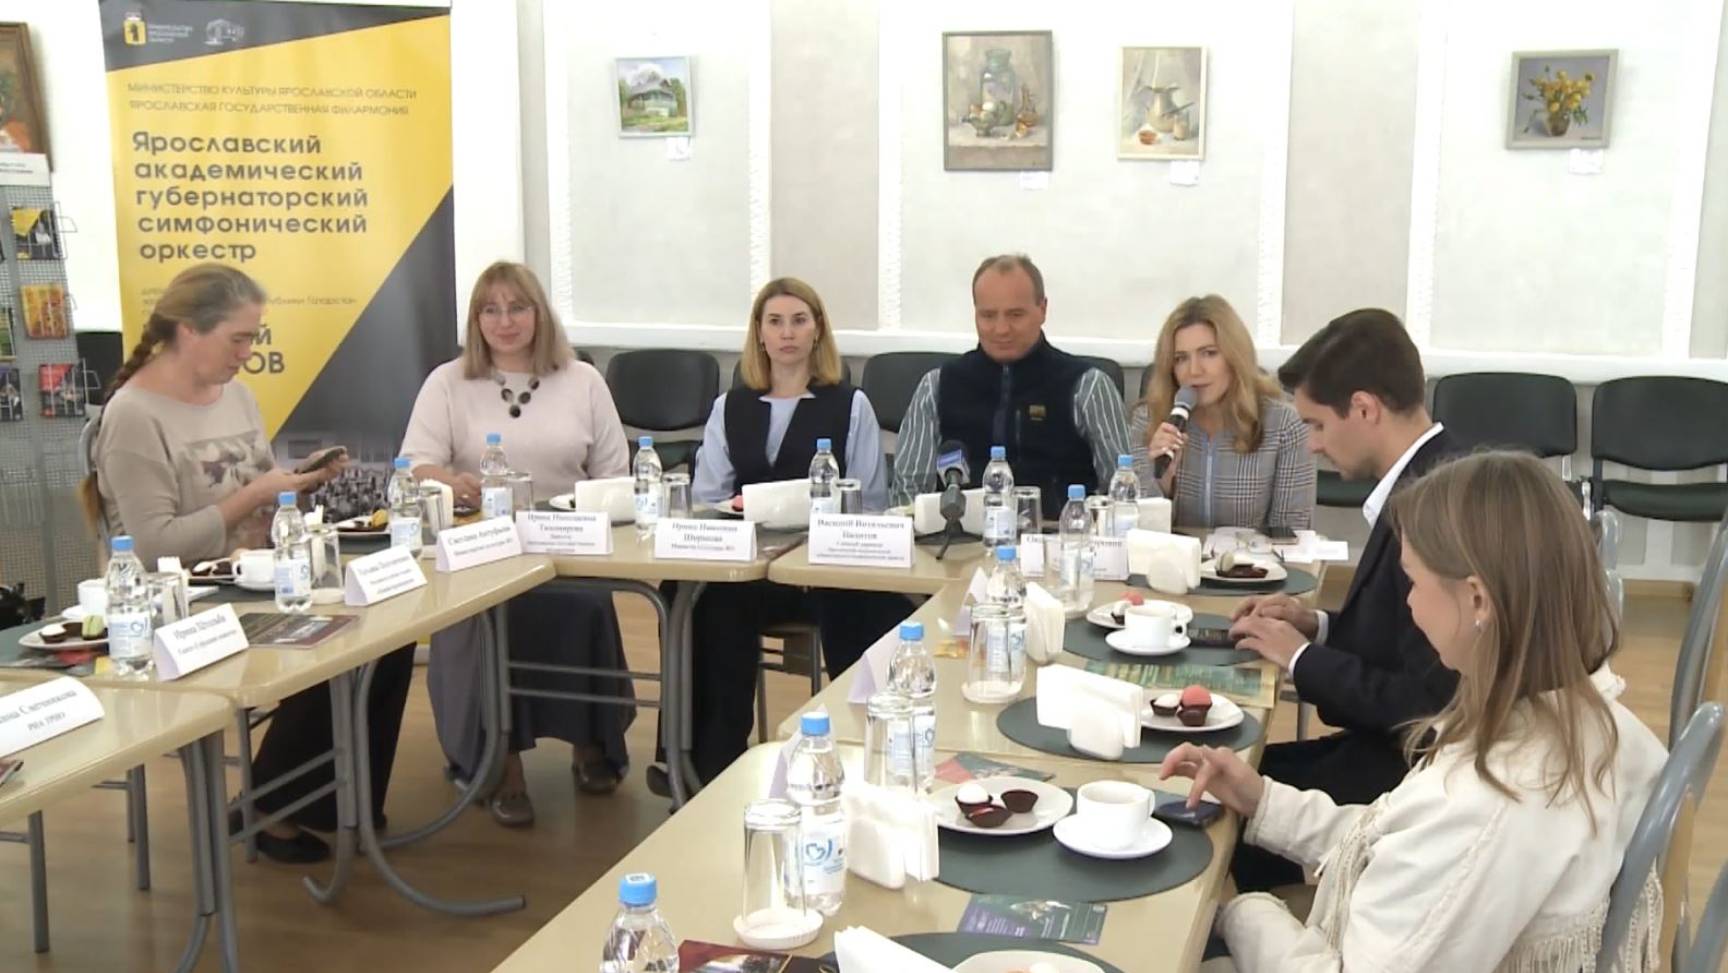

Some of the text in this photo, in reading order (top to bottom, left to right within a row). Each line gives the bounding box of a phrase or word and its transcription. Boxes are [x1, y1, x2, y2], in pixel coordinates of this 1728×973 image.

[221, 85, 276, 96] КУЛЬТУРЫ
[129, 100, 217, 112] ЯРОСЛАВСКАЯ
[132, 131, 322, 156] Ярославский
[135, 162, 363, 181] академический
[136, 186, 369, 210] губернаторский
[138, 214, 367, 234] симфонический
[139, 243, 256, 263] оркестр
